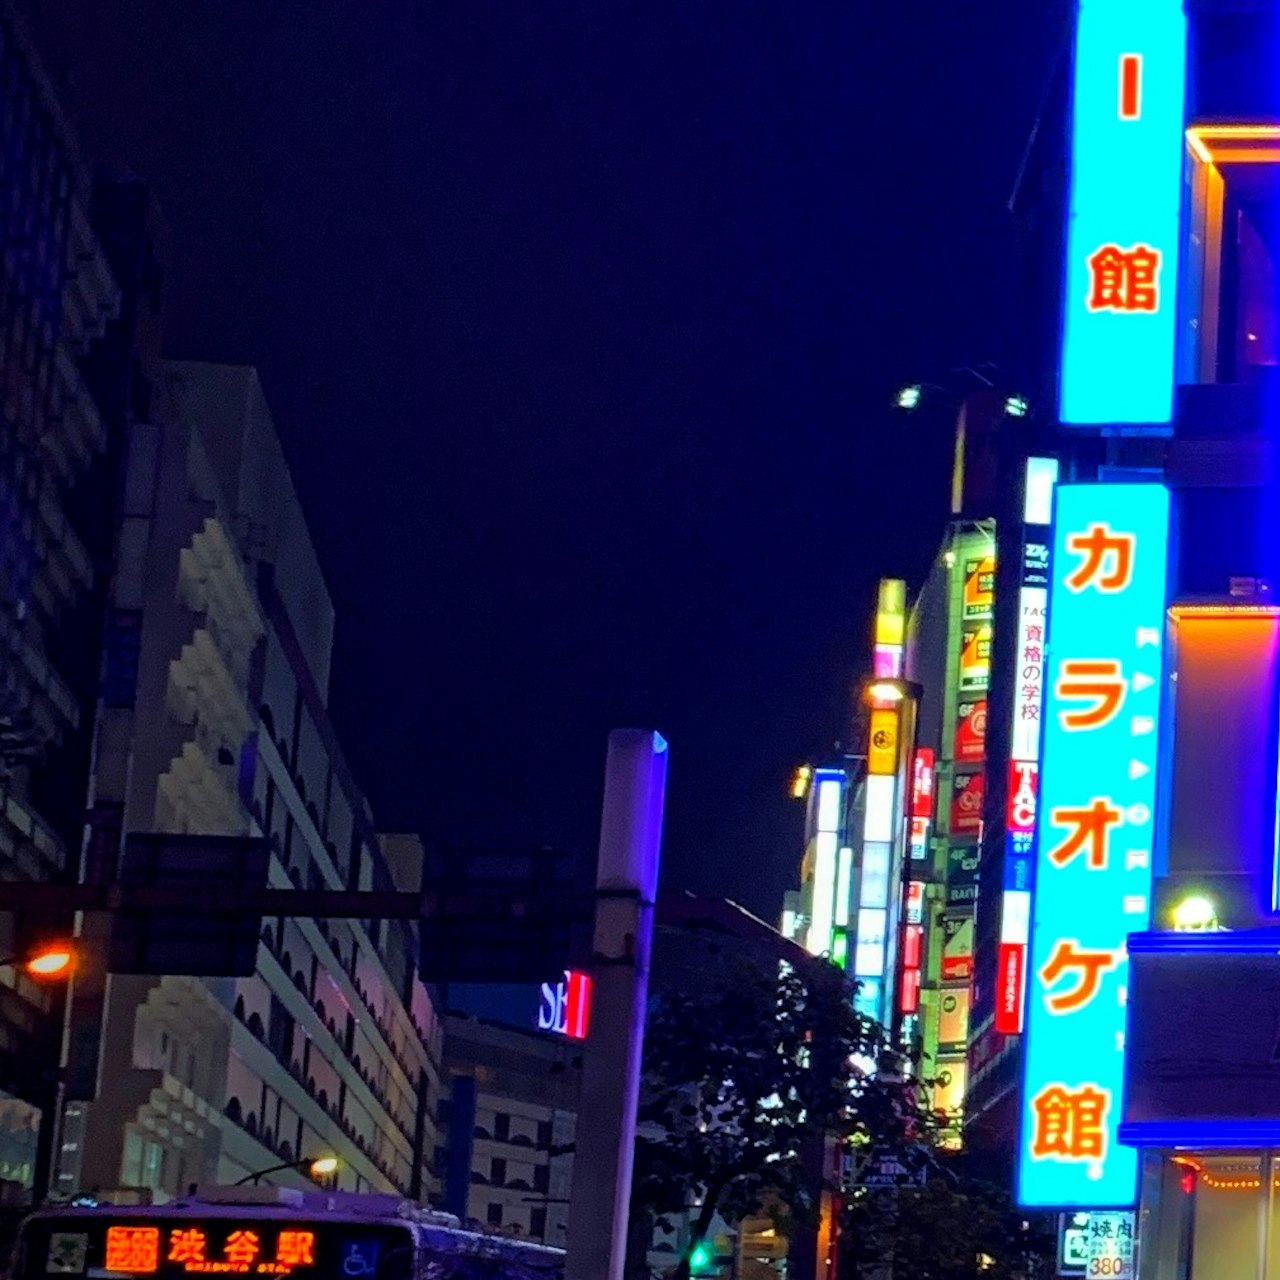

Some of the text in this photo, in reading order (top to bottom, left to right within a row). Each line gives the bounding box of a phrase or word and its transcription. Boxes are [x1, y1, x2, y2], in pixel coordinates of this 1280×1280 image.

[1021, 624, 1042, 720] 資格の学校
[1012, 762, 1037, 827] TAC
[1031, 524, 1134, 1163] カラオケ館
[168, 1228, 314, 1264] 渋谷駅
[1091, 1219, 1132, 1239] 焼肉
